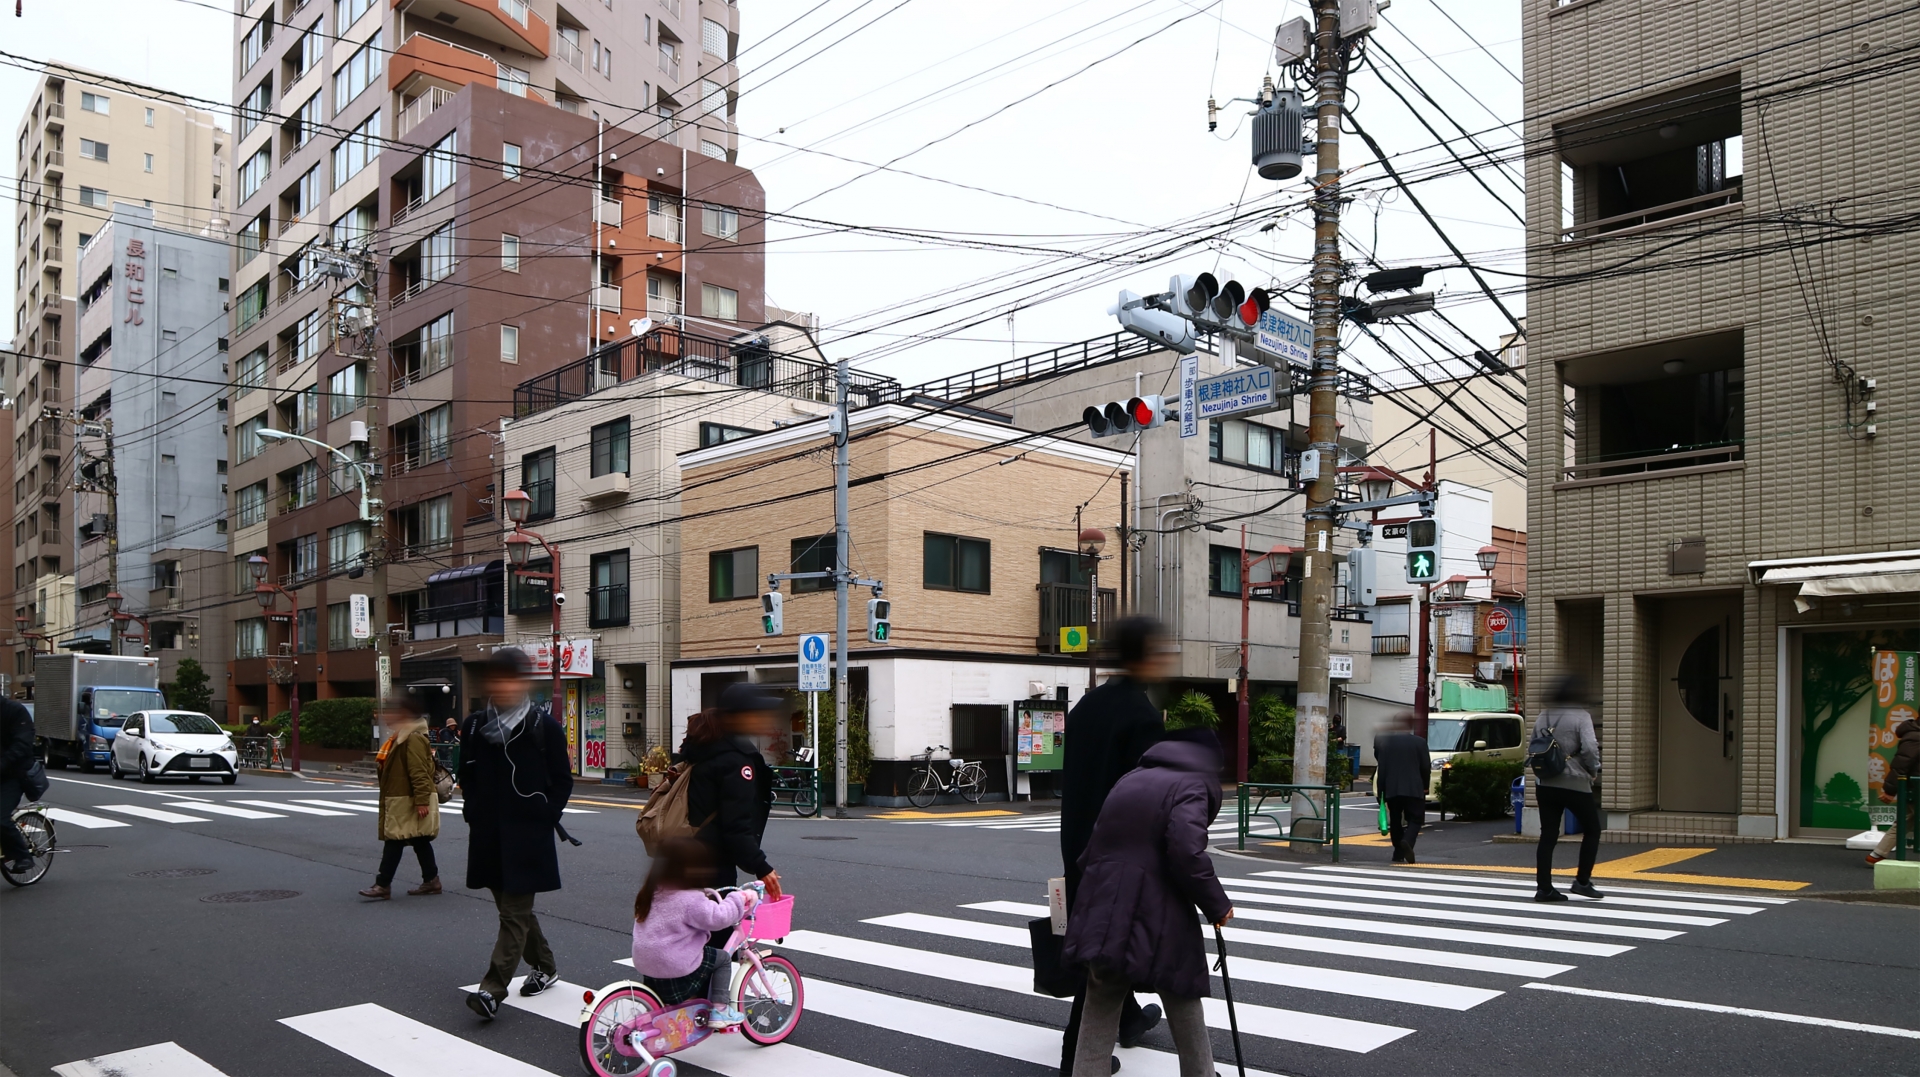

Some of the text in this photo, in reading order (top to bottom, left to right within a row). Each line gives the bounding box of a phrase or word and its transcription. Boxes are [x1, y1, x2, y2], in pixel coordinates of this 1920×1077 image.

[124, 238, 146, 326] 長和ビル
[1259, 311, 1312, 349] 根津神社入口
[1260, 332, 1308, 361] Nezujinja Shrine
[1198, 371, 1270, 402] 根津神社入口
[1184, 378, 1194, 434] 歩車分離式
[1202, 393, 1268, 414] Nezujinja Shrine
[1384, 527, 1407, 536] 文豪の
[1489, 616, 1507, 626] 消火栓
[1873, 652, 1896, 703] はり
[1903, 655, 1916, 702] 各種保険
[1871, 814, 1895, 823] 5809
